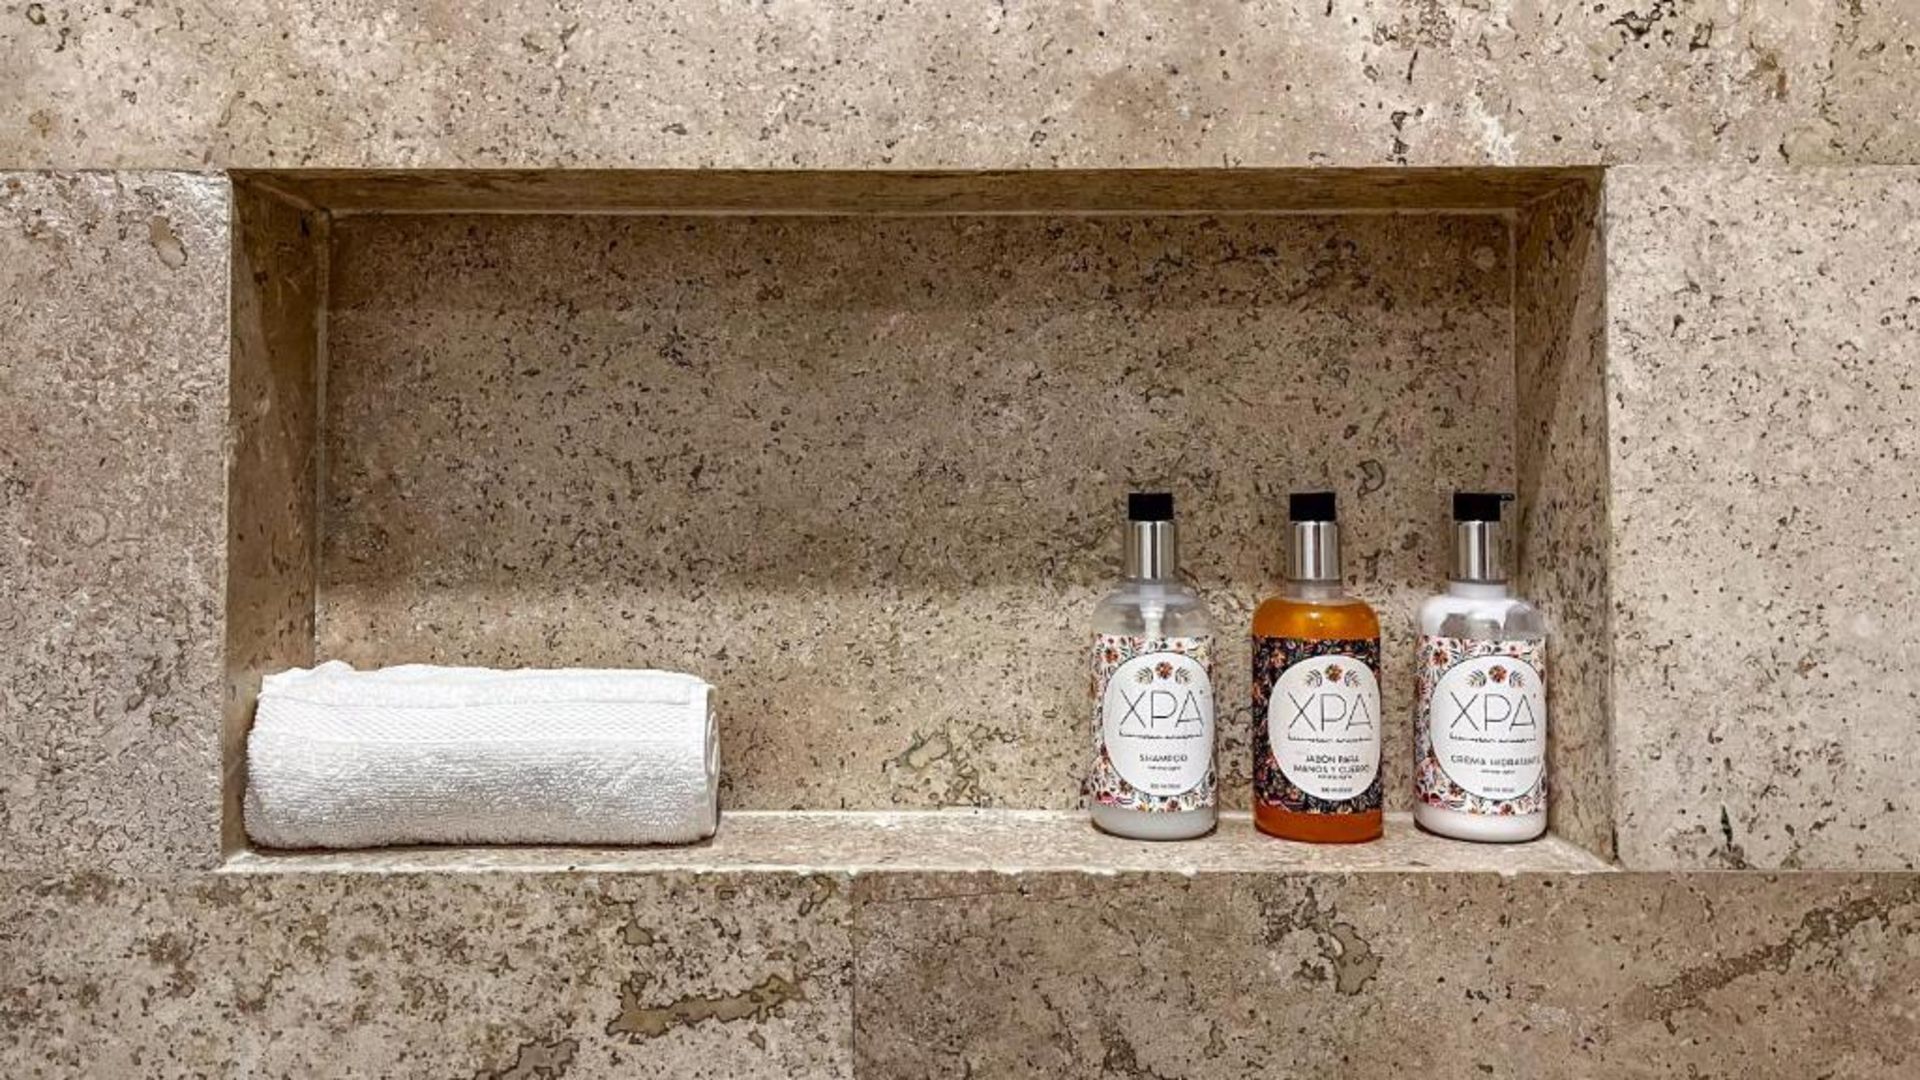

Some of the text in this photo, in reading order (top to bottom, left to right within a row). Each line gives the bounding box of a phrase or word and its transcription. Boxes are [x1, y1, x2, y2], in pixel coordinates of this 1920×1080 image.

[1119, 690, 1203, 728] XPA
[1287, 692, 1373, 732] XPA
[1450, 692, 1536, 731] XPA
